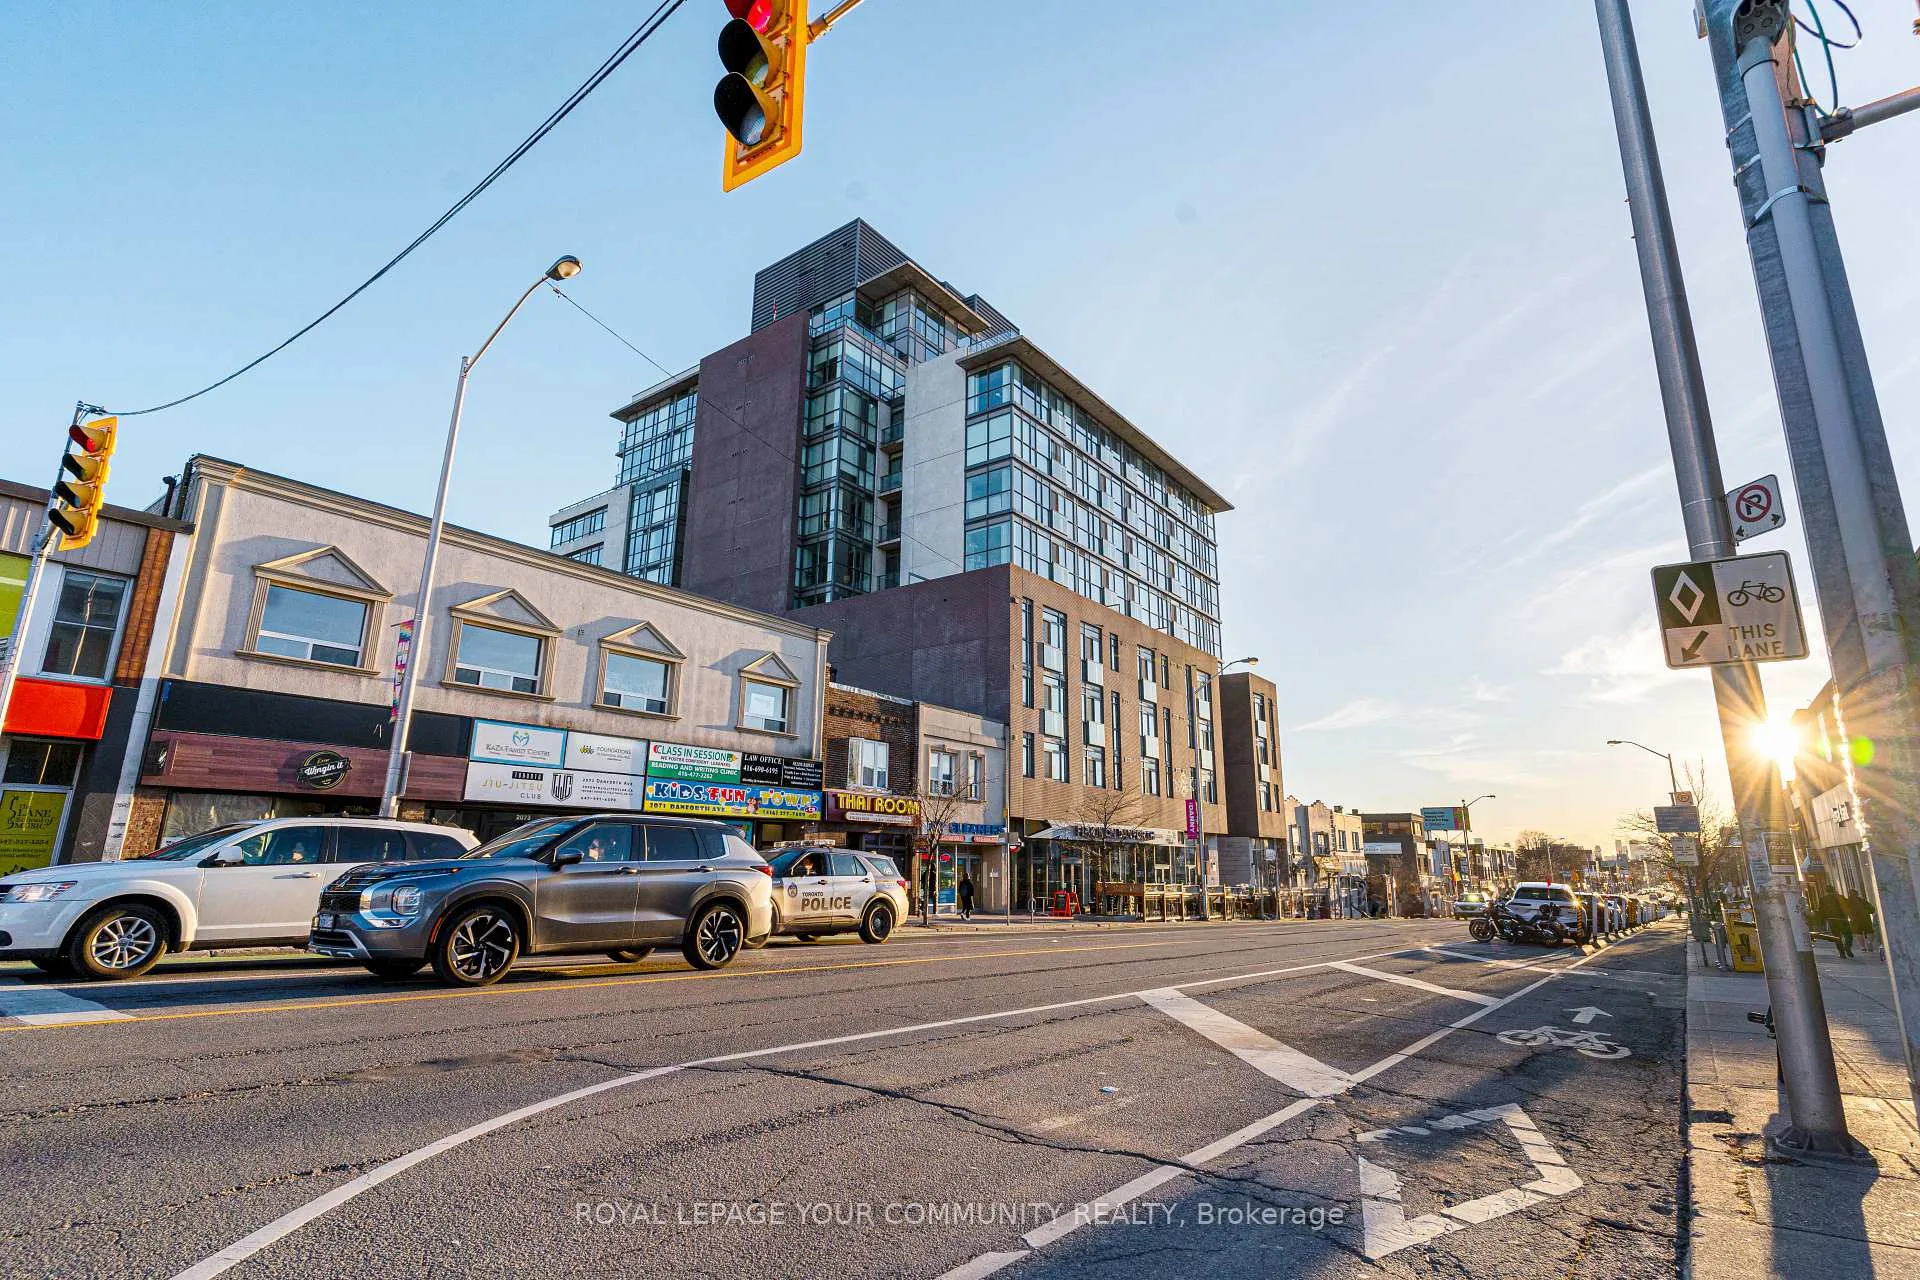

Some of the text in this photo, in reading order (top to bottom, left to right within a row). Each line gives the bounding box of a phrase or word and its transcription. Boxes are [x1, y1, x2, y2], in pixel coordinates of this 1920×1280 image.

[1729, 623, 1776, 638] THIS
[1727, 640, 1785, 659] LANE
[653, 744, 728, 762] CLASS IN SESSION
[744, 754, 782, 765] LAW OFFICE
[651, 762, 679, 770] READING
[679, 764, 694, 772] AND
[694, 766, 719, 774] WRITING
[520, 792, 542, 800] CLUB
[653, 781, 704, 801] KIDS
[706, 786, 746, 802] FUN
[760, 790, 813, 807] TOWN
[837, 793, 921, 815] THAI ROOM
[801, 896, 851, 912] POLICE
